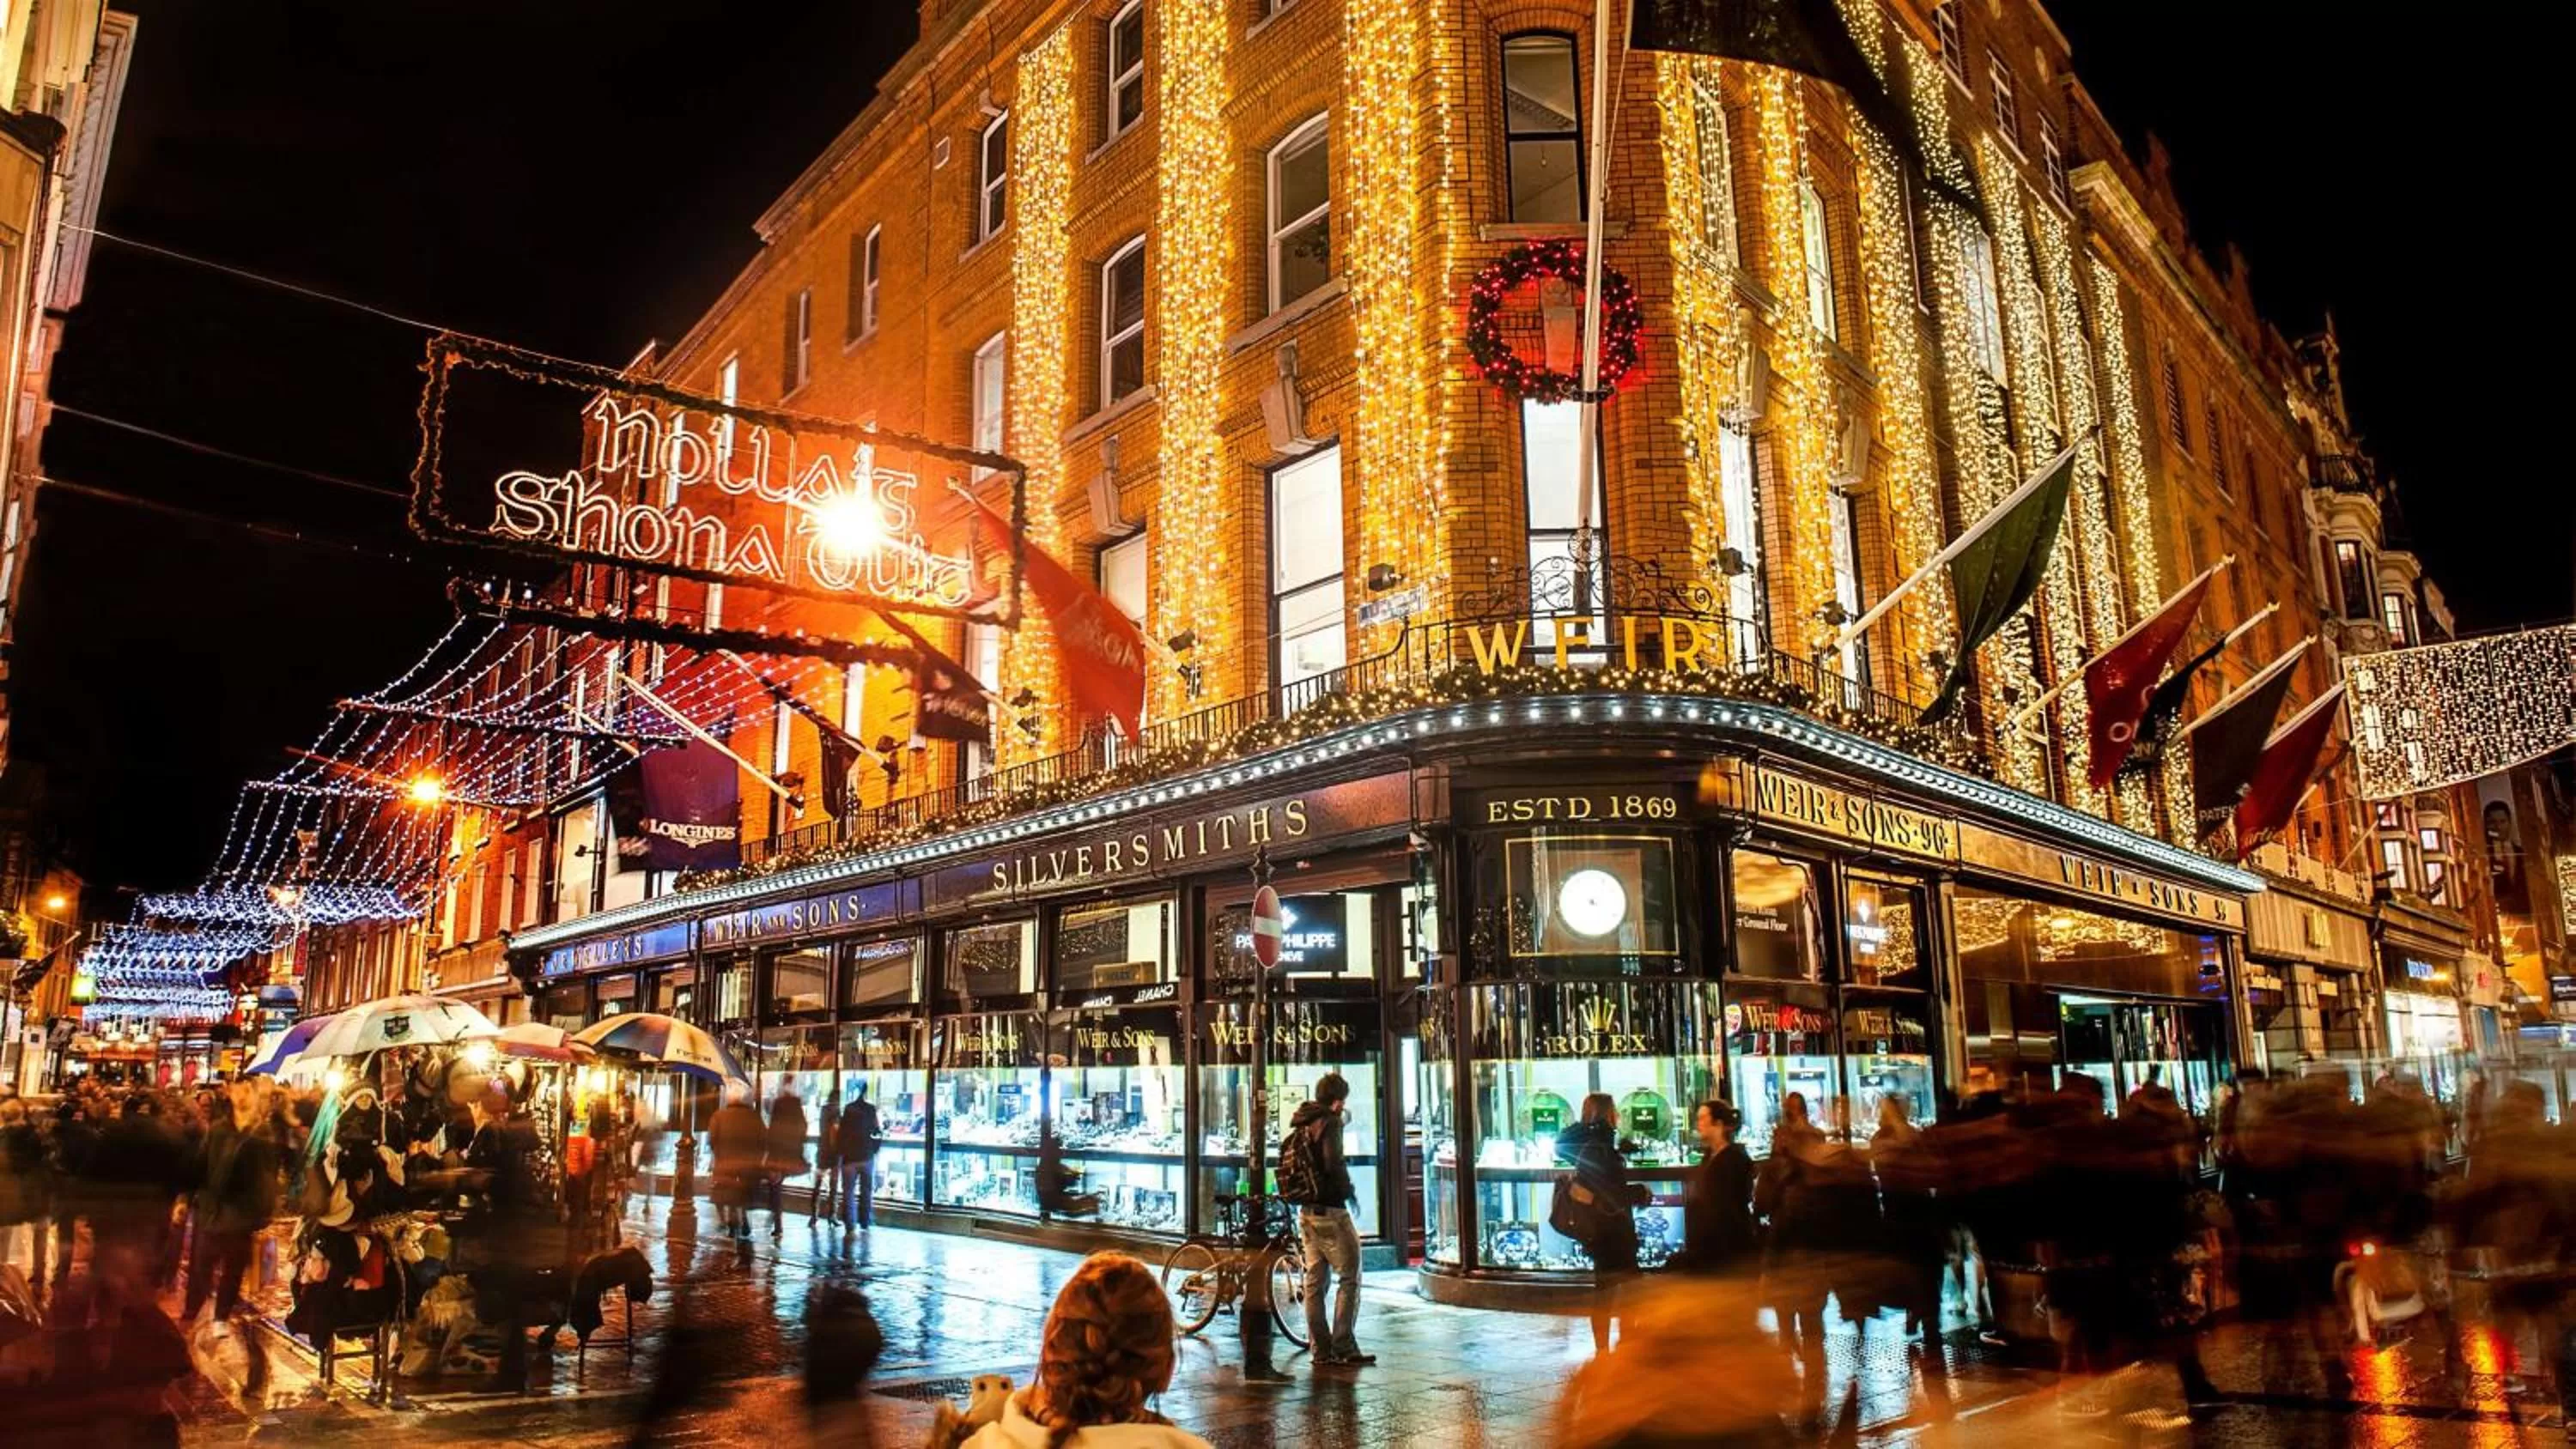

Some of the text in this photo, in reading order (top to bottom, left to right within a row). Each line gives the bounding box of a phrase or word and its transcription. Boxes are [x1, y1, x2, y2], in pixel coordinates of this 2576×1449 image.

[1466, 615, 1703, 676] WEIR
[1486, 796, 1677, 823] ESTD 1869
[1758, 772, 1827, 826] WEIR
[648, 818, 737, 840] LONGINES
[992, 799, 1308, 892] SILVERSMITHS
[2059, 855, 2123, 896] WEIR
[2149, 879, 2199, 916] SONS
[714, 909, 762, 942] WEIR
[1077, 1026, 1155, 1048] WEIR & SONS
[1210, 1022, 1256, 1045] WEI
[1547, 1033, 1649, 1055] ROLEX
